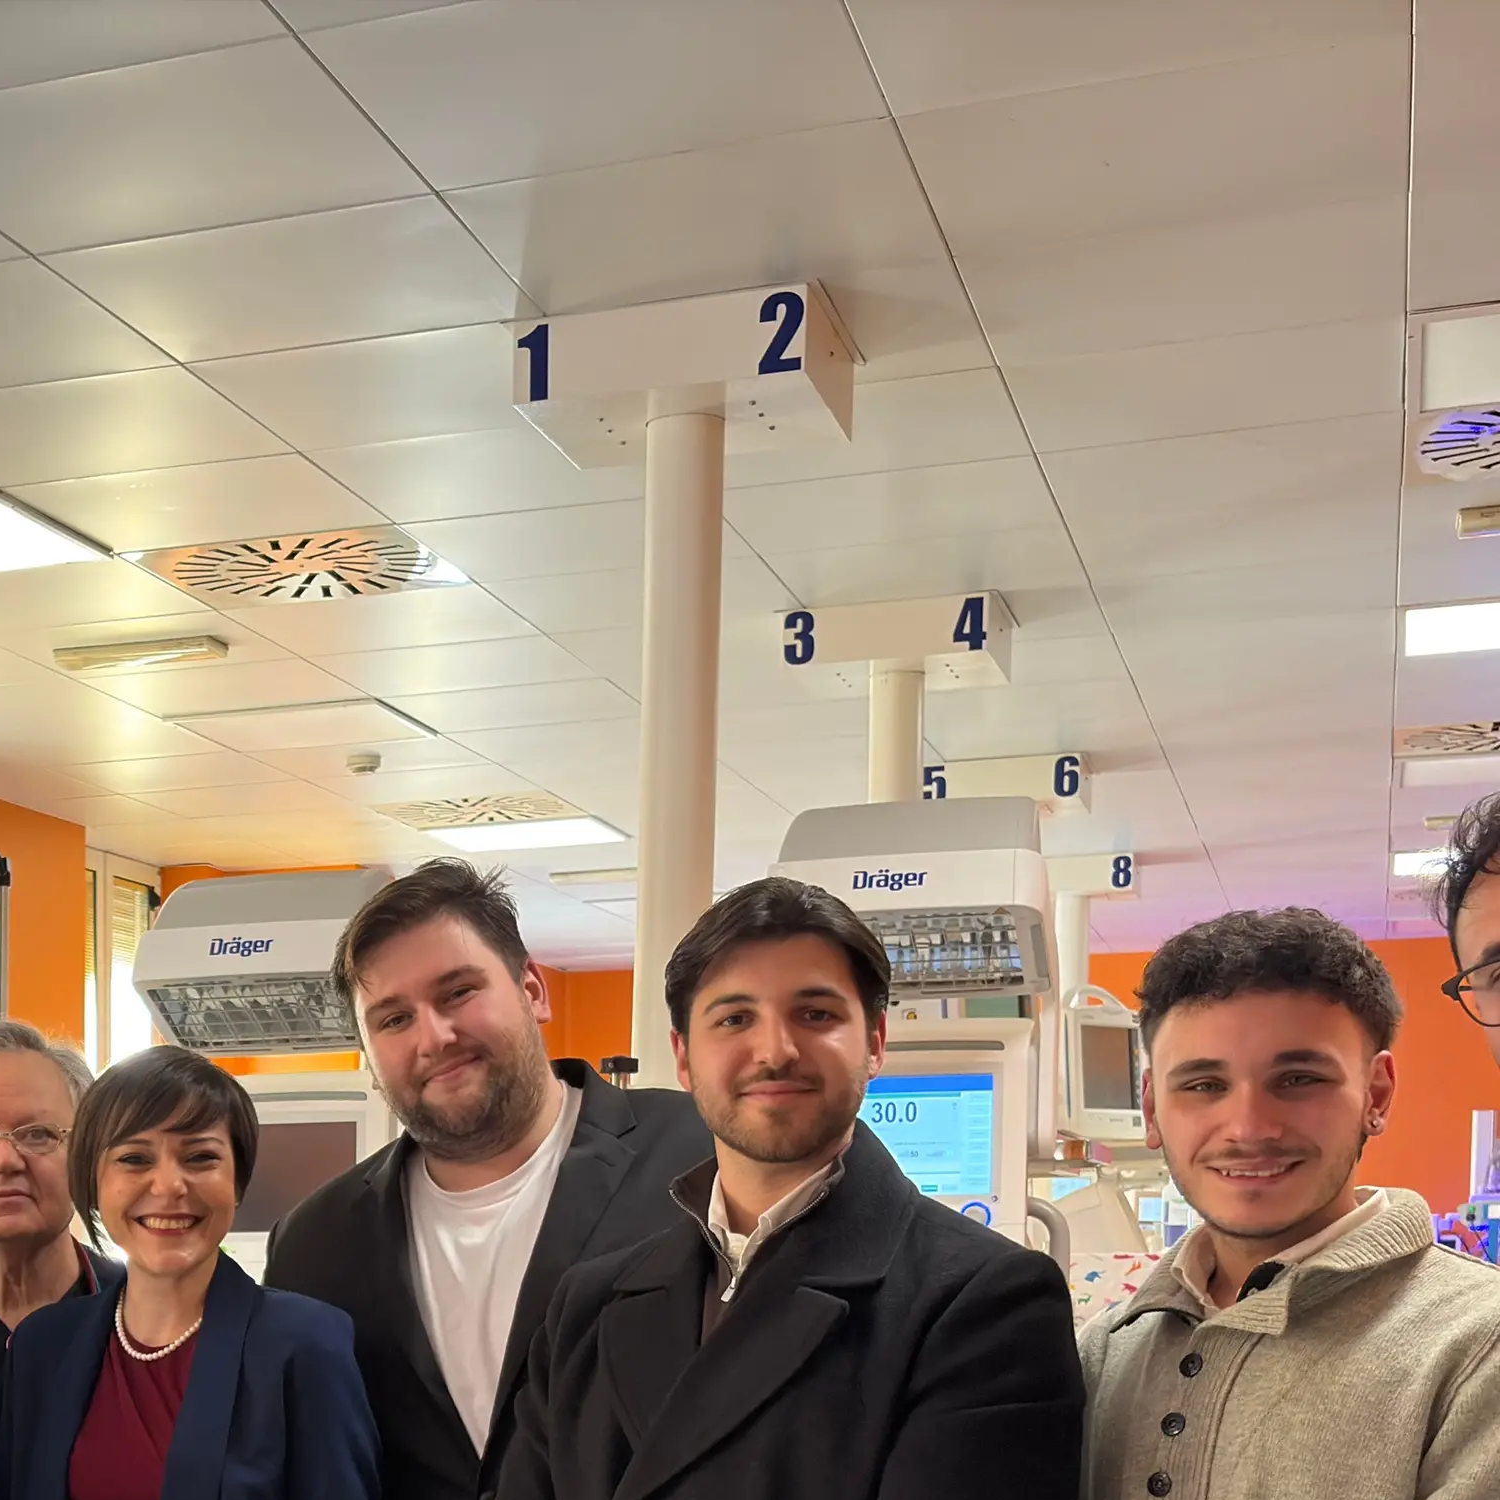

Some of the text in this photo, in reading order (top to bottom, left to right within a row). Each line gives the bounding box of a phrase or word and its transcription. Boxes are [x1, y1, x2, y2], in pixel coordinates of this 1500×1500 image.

[517, 291, 805, 402] 1 2
[784, 597, 987, 665] 3 4
[922, 756, 1079, 800] 5 6
[852, 868, 928, 891] Dräger
[1111, 855, 1132, 888] 8
[209, 936, 274, 957] Dräger
[871, 1101, 918, 1124] 30.0
